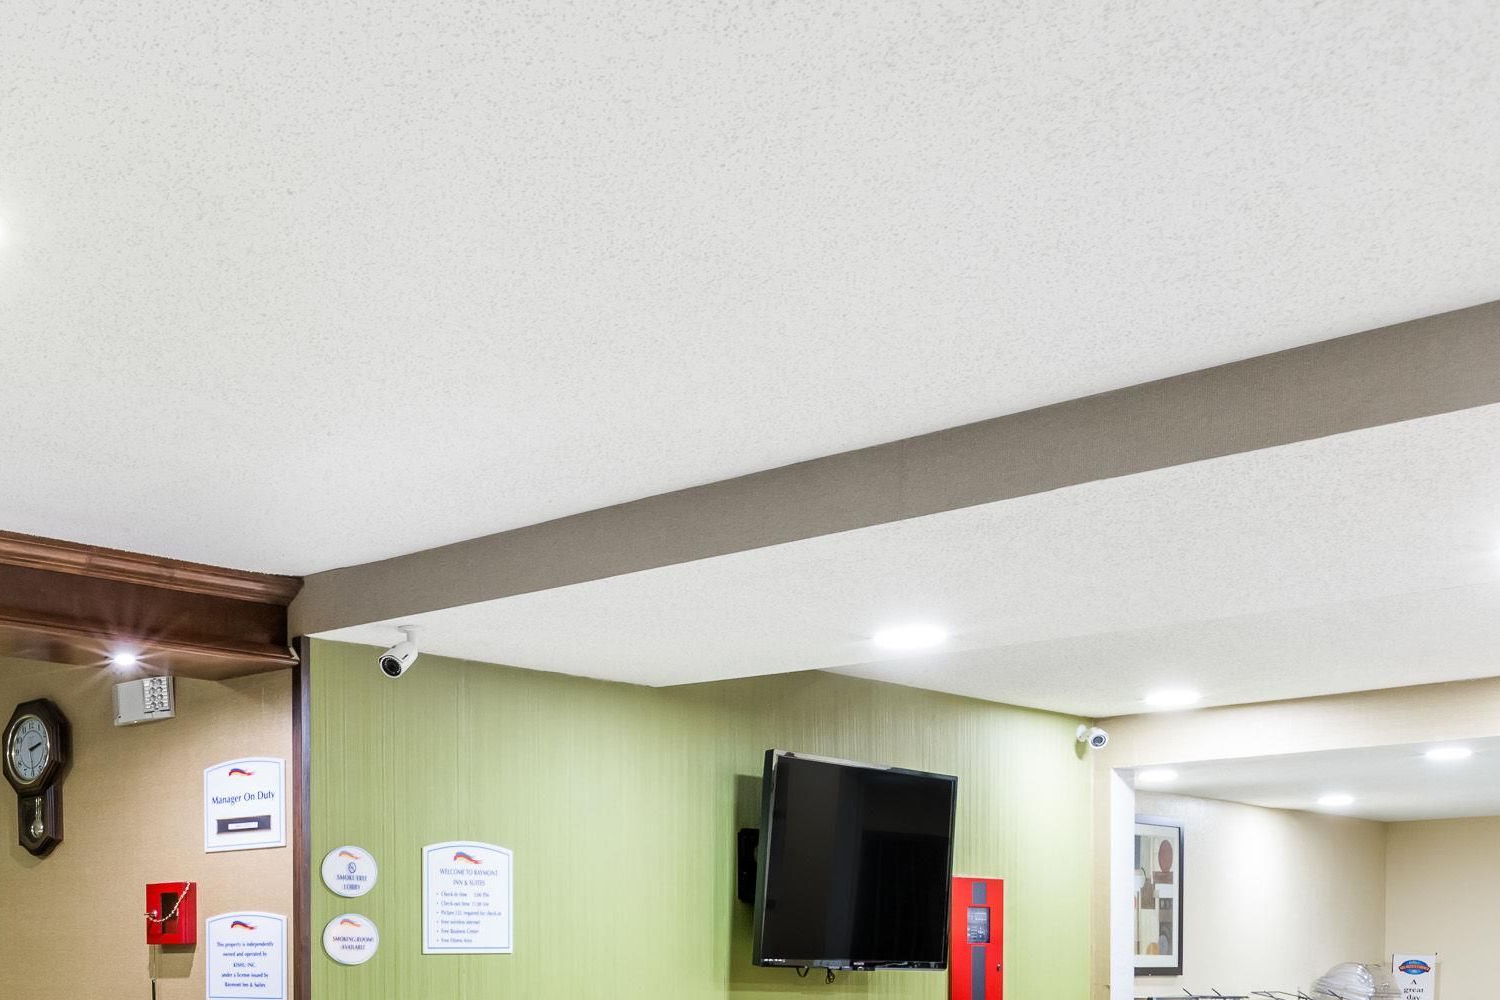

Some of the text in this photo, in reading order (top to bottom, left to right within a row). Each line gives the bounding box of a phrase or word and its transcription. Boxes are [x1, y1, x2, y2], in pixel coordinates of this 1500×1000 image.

[212, 790, 275, 806] Manager On Duty
